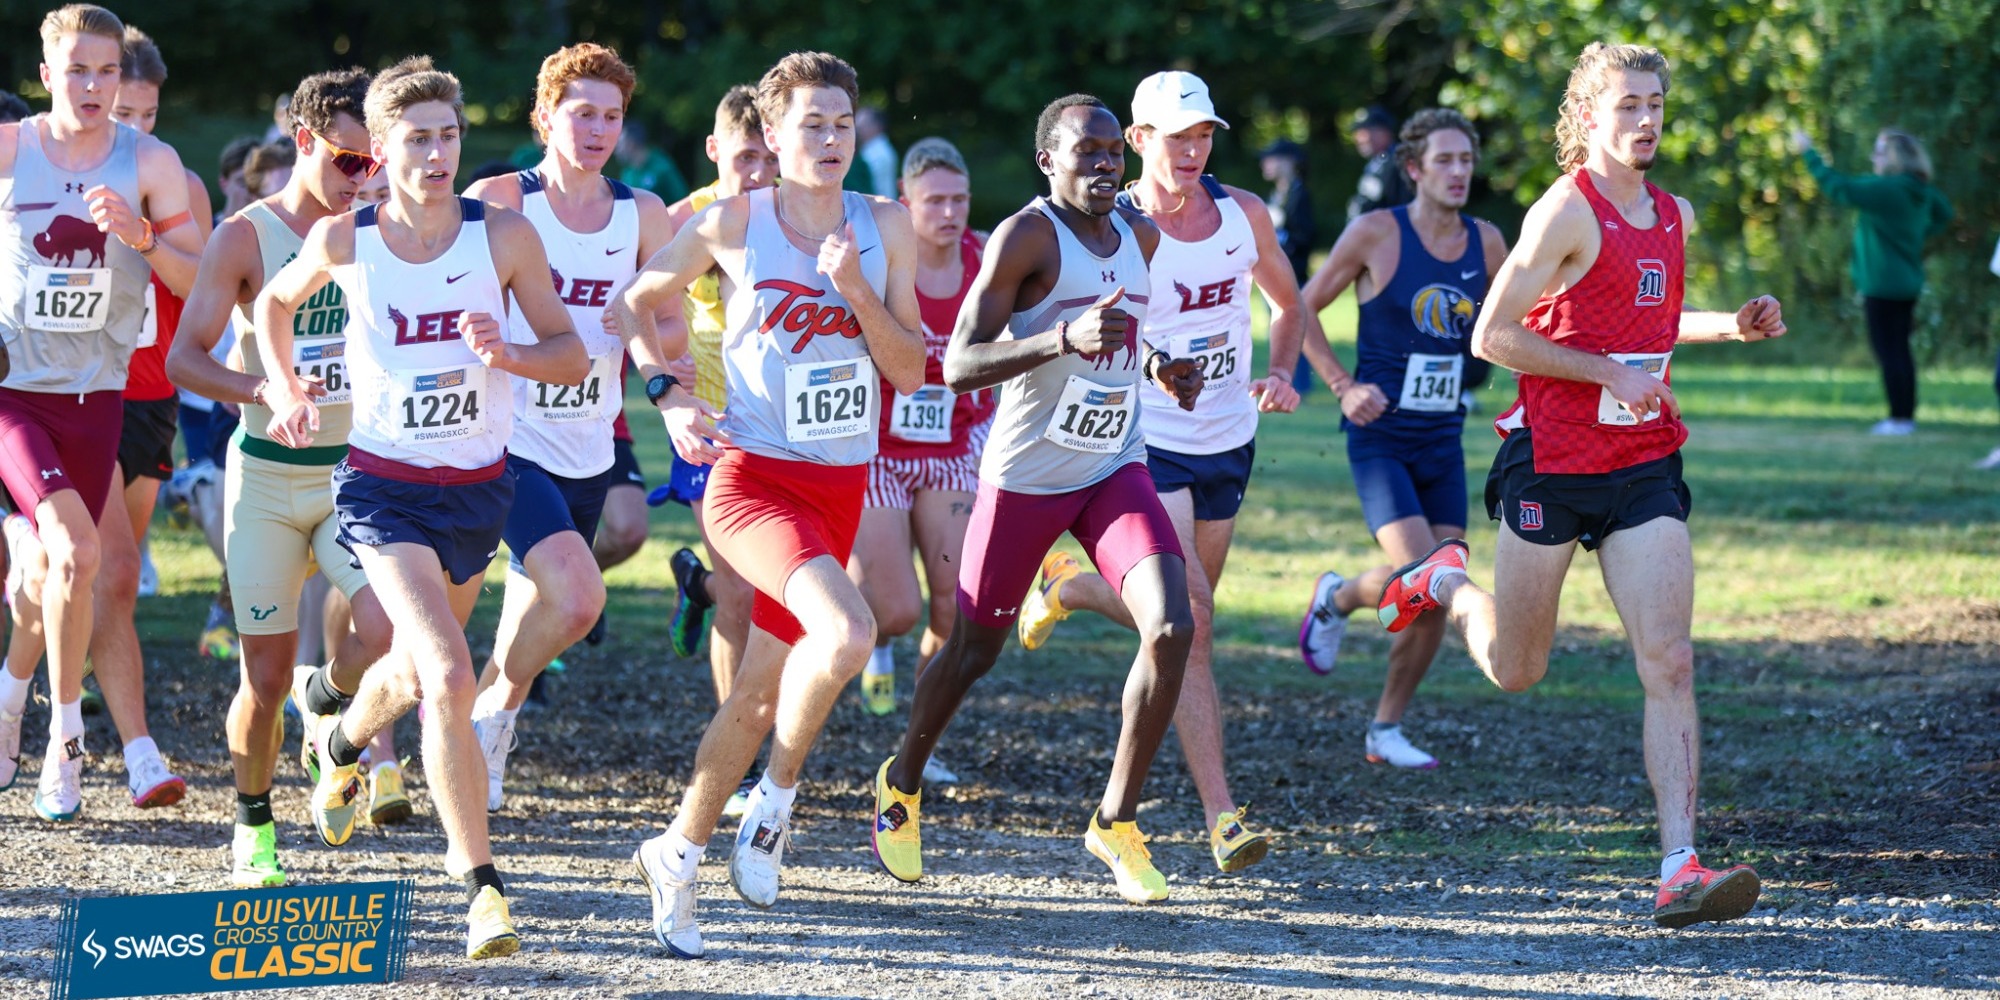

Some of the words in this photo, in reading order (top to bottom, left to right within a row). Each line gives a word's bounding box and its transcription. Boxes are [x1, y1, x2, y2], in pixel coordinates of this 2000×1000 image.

[35, 290, 103, 318] 1627
[1173, 277, 1236, 313] LEE
[43, 321, 91, 329] #SWAGSXCC
[388, 303, 465, 346] LEE
[535, 377, 600, 408] 1234
[1411, 376, 1455, 399] 1341
[402, 390, 479, 428] 1224
[544, 410, 590, 419] #SWAGSXCC
[797, 385, 866, 425] 1629
[901, 405, 944, 429] 1391
[414, 427, 469, 440] #SWAGSXCC
[807, 424, 858, 437] #SWAGSXCC
[1059, 403, 1128, 439] 1623
[1063, 438, 1109, 450] #SWAGSXCC
